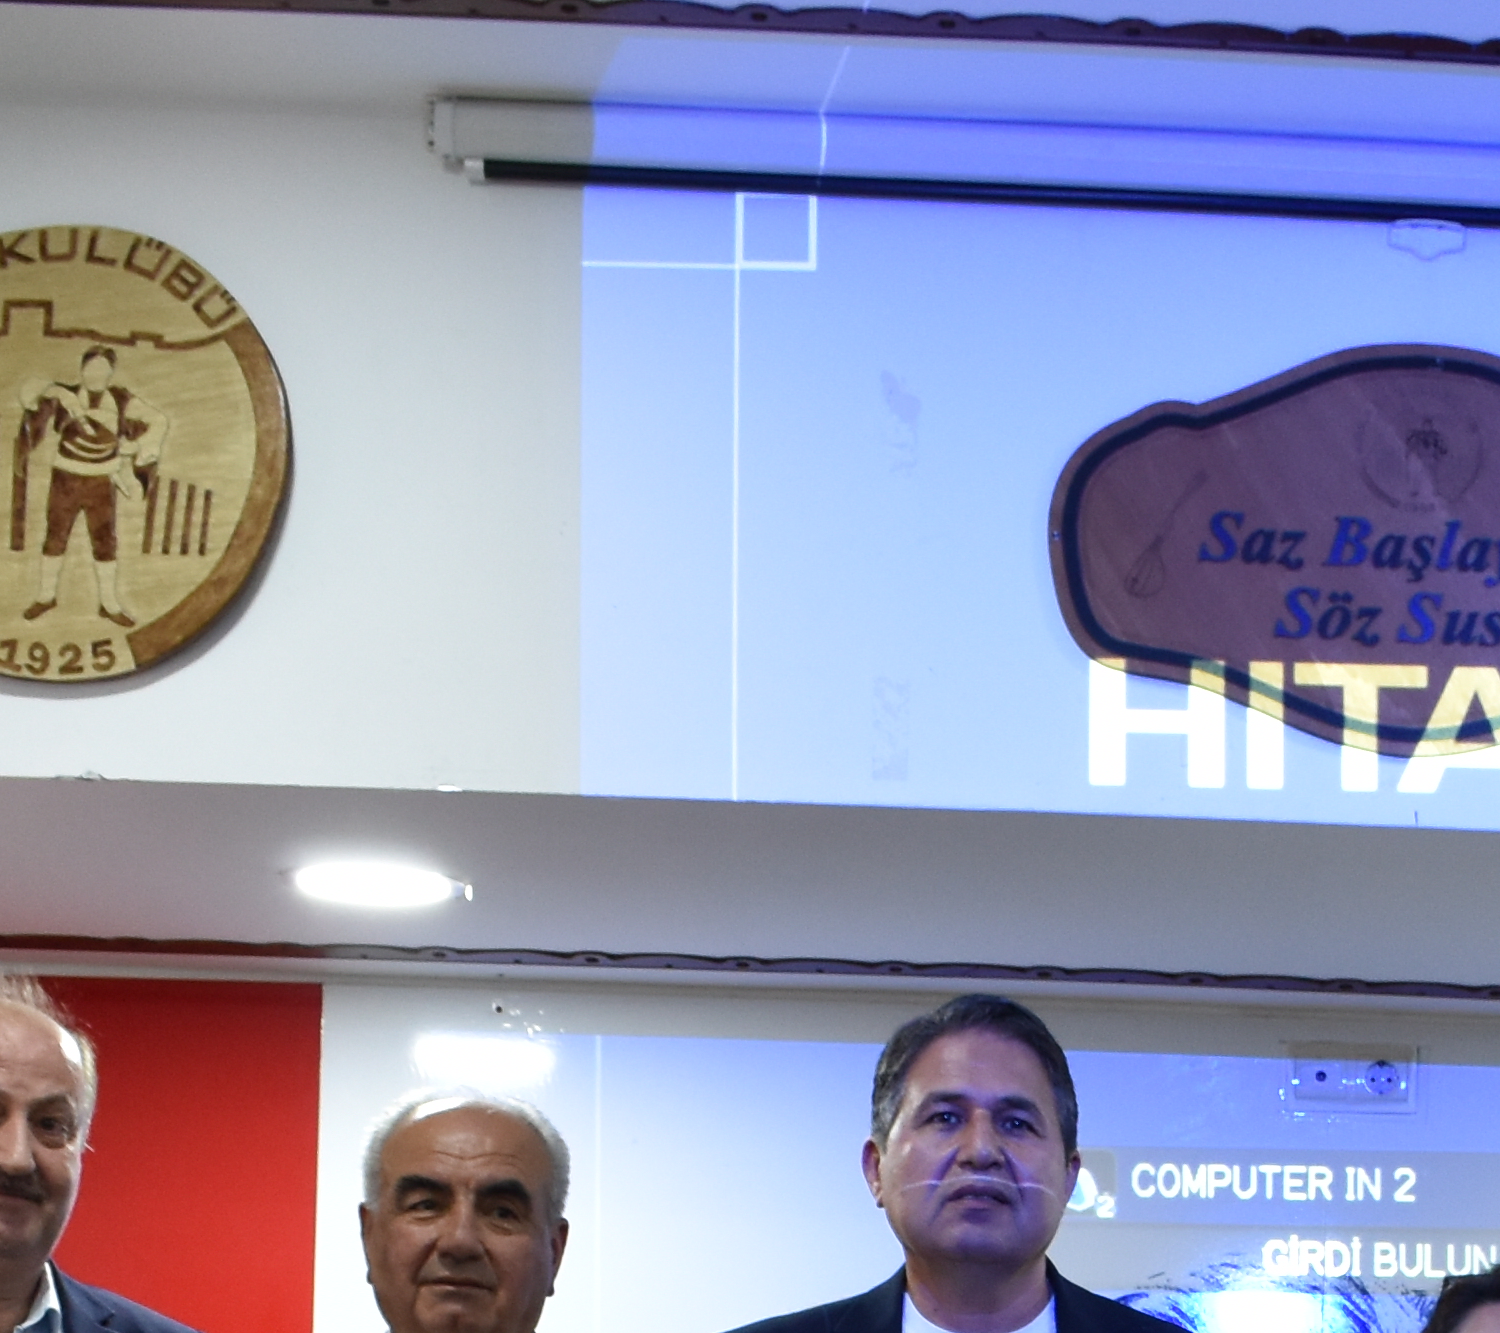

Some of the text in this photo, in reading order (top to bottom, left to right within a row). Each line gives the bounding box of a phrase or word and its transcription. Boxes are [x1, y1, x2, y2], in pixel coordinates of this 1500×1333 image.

[1198, 510, 1307, 569] Saz
[1273, 586, 1383, 647] Söz
[1131, 1163, 1417, 1203] COMPUTER IN 2
[1096, 1194, 1116, 1219] 2
[1261, 1233, 1363, 1278] GİRDİ
